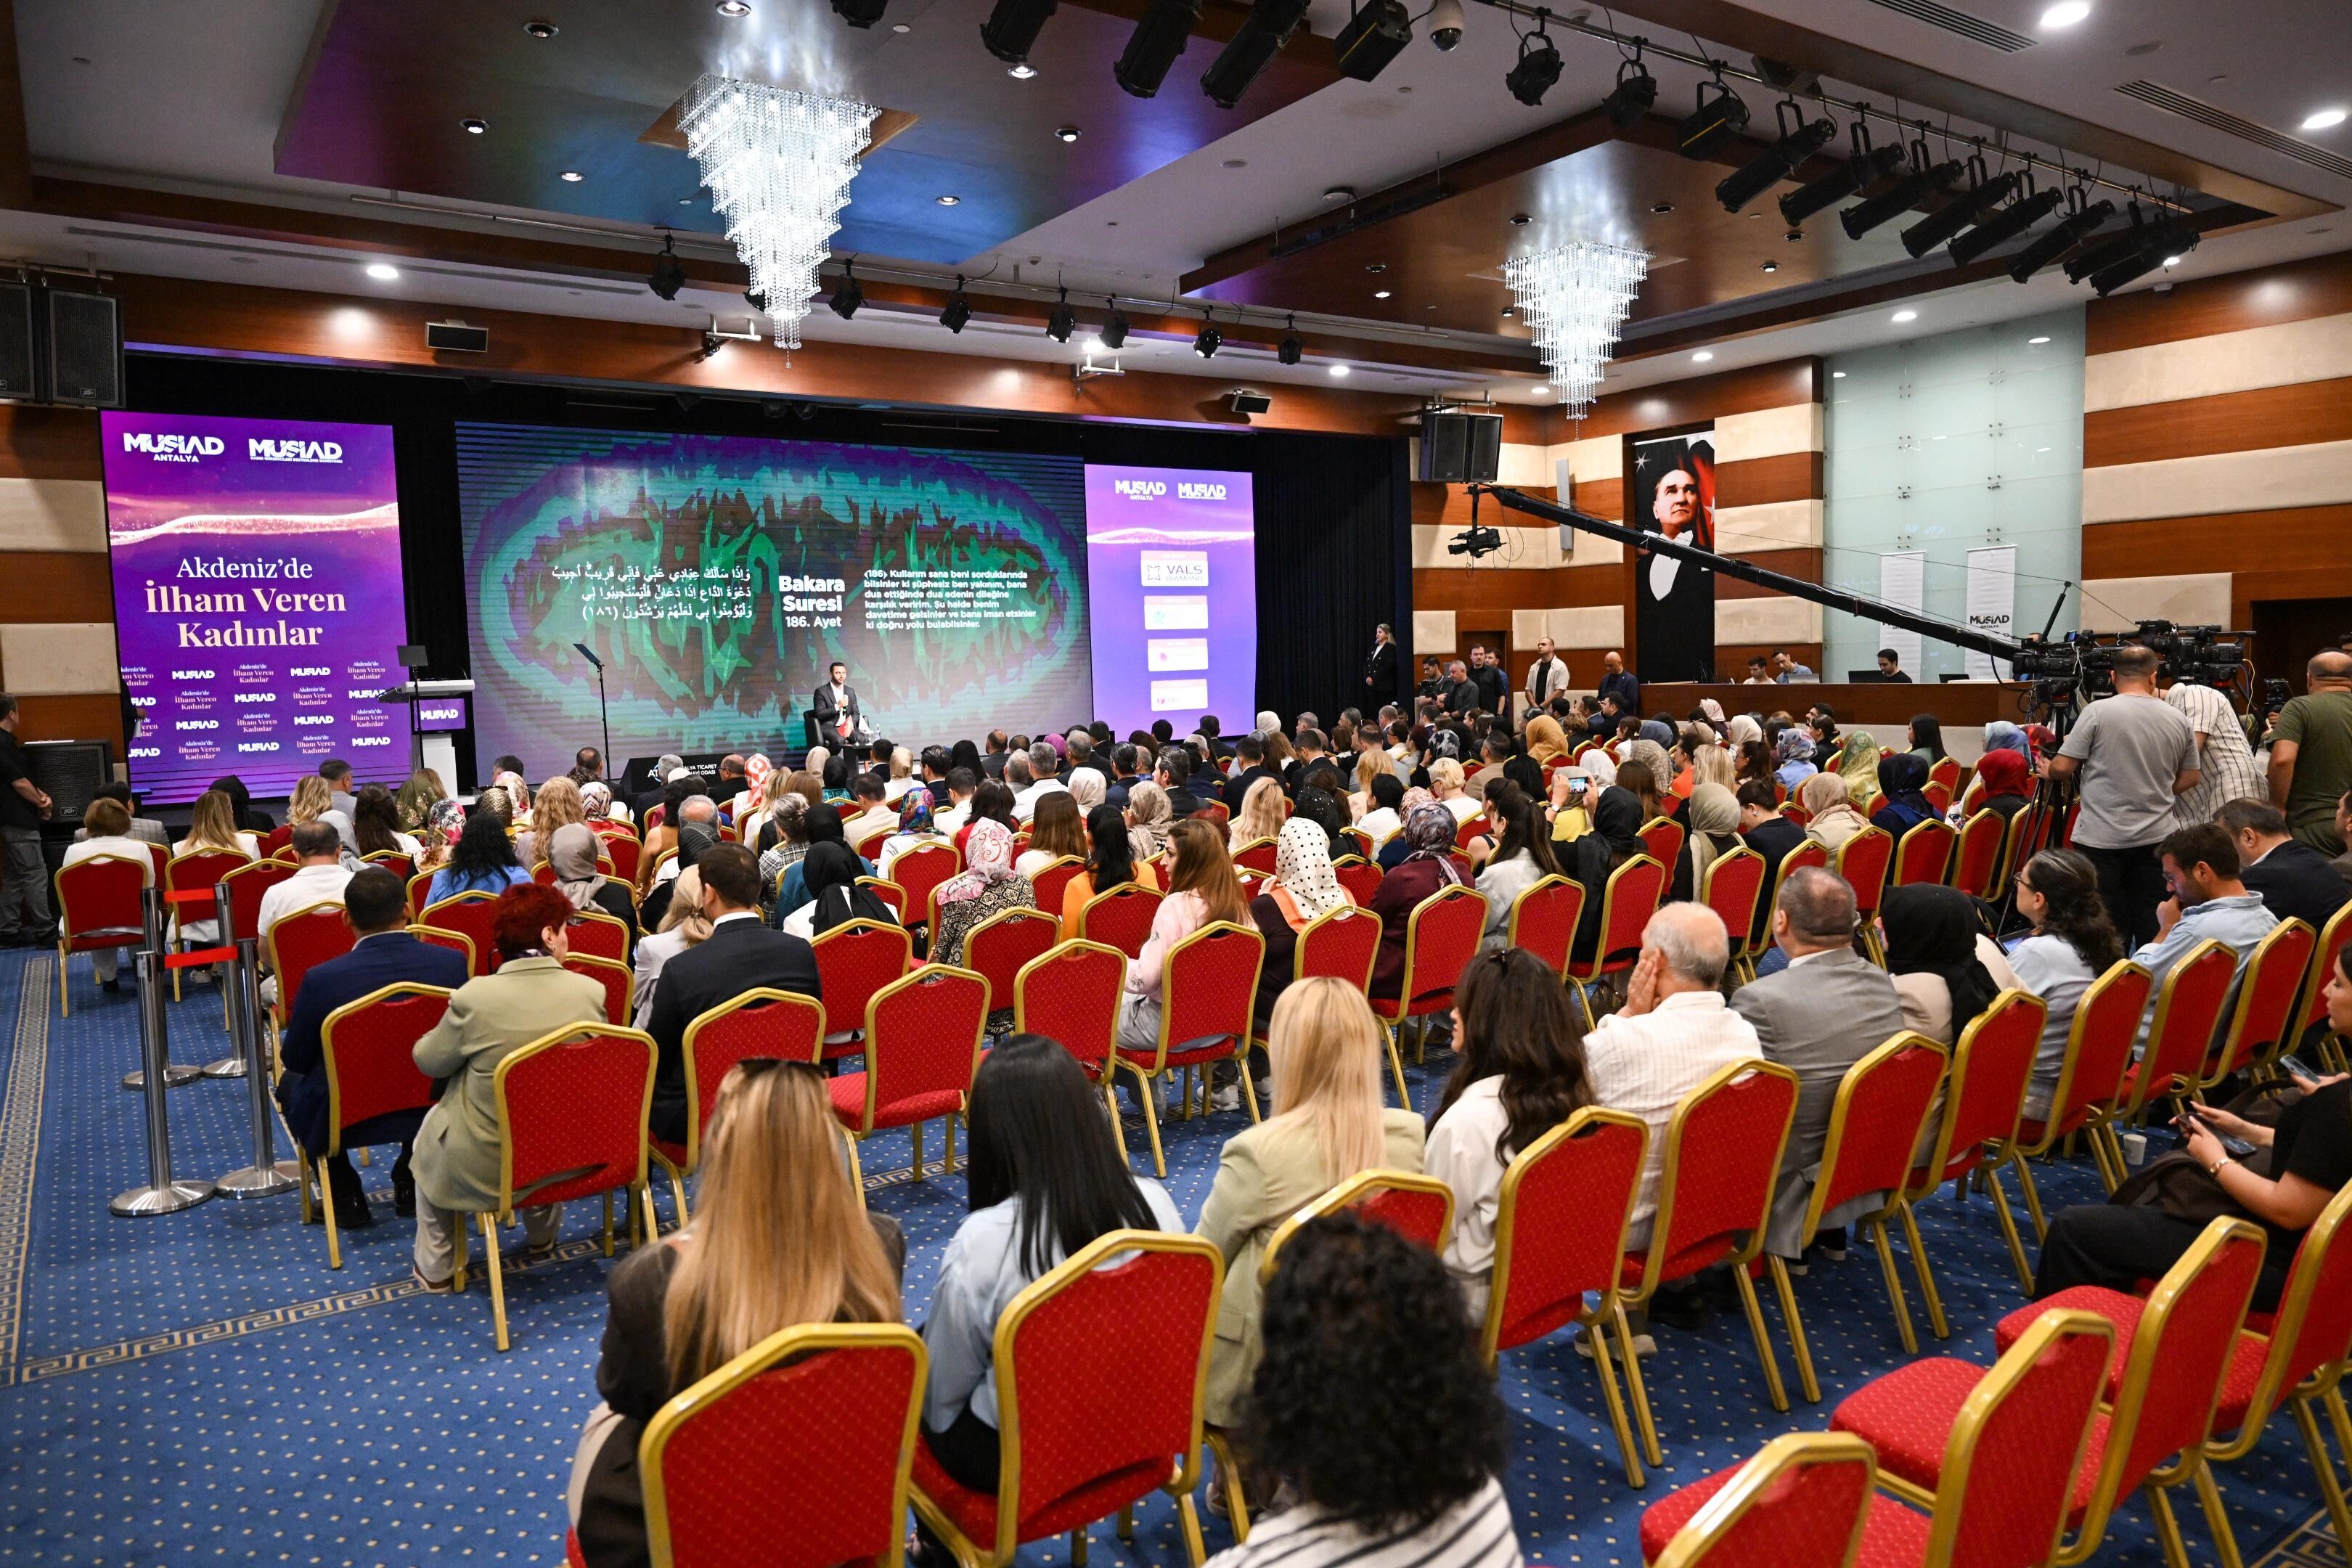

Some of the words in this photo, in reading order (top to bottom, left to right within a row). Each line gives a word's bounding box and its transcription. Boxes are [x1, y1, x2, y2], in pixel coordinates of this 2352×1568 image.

[153, 454, 199, 462] ANTALYA
[1167, 565, 1203, 574] VALS
[778, 575, 845, 592] Bakara
[145, 580, 246, 613] İlham
[252, 588, 347, 612] Veren
[783, 595, 842, 612] Suresi
[934, 600, 945, 609] Şu
[785, 616, 810, 628] 186.
[813, 616, 842, 629] Ayet
[905, 621, 925, 629] yolu
[176, 620, 323, 648] Kadınlar
